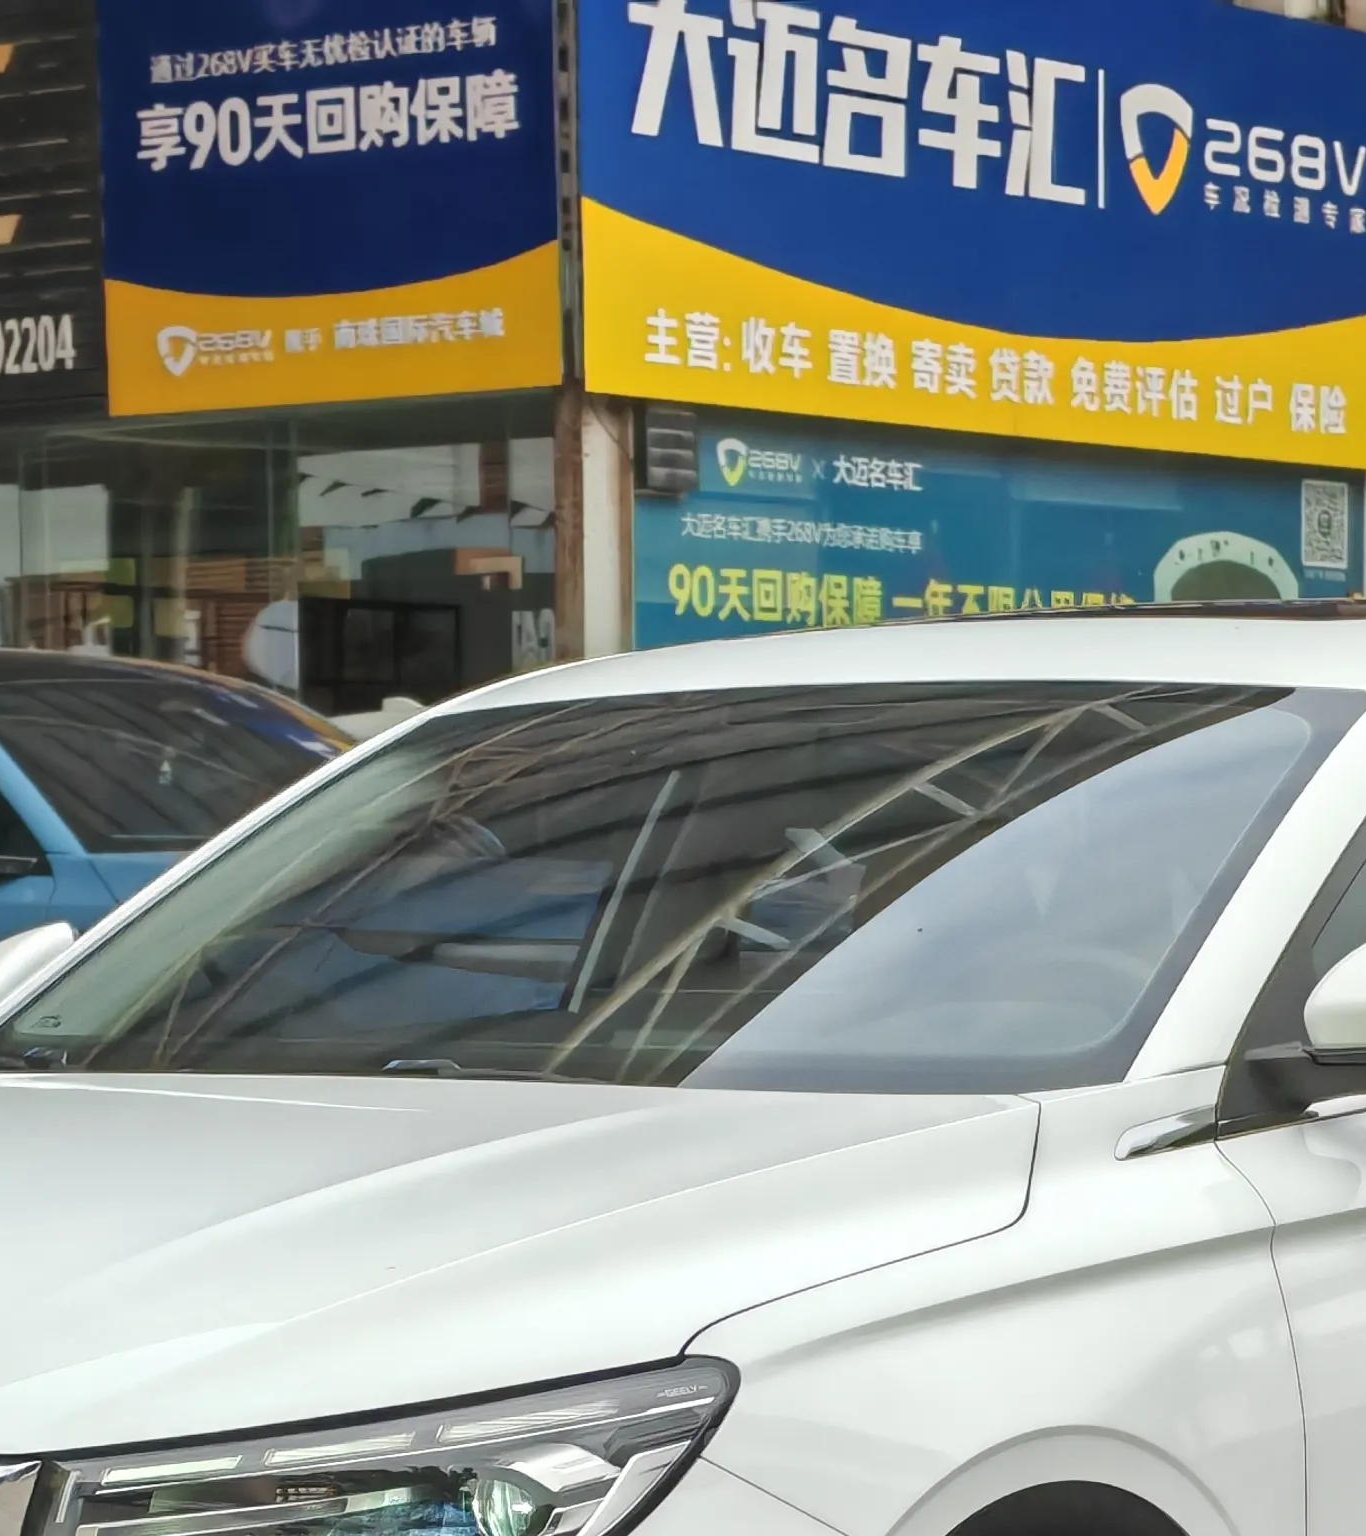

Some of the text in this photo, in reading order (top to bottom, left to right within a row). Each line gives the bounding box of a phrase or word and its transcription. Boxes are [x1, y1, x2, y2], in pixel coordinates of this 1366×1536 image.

[136, 69, 520, 171] 享90天回购保障
[628, 0, 1086, 206] 大迈名车汇
[827, 329, 897, 390] 置换
[911, 338, 979, 400] 寄卖
[989, 347, 1056, 406] 贷款
[1070, 356, 1200, 422] 免费评估
[1214, 374, 1274, 425] 过户
[1289, 382, 1348, 434] 保险
[831, 453, 925, 492] 大迈名车汇
[668, 563, 883, 627] 90天回购保障
